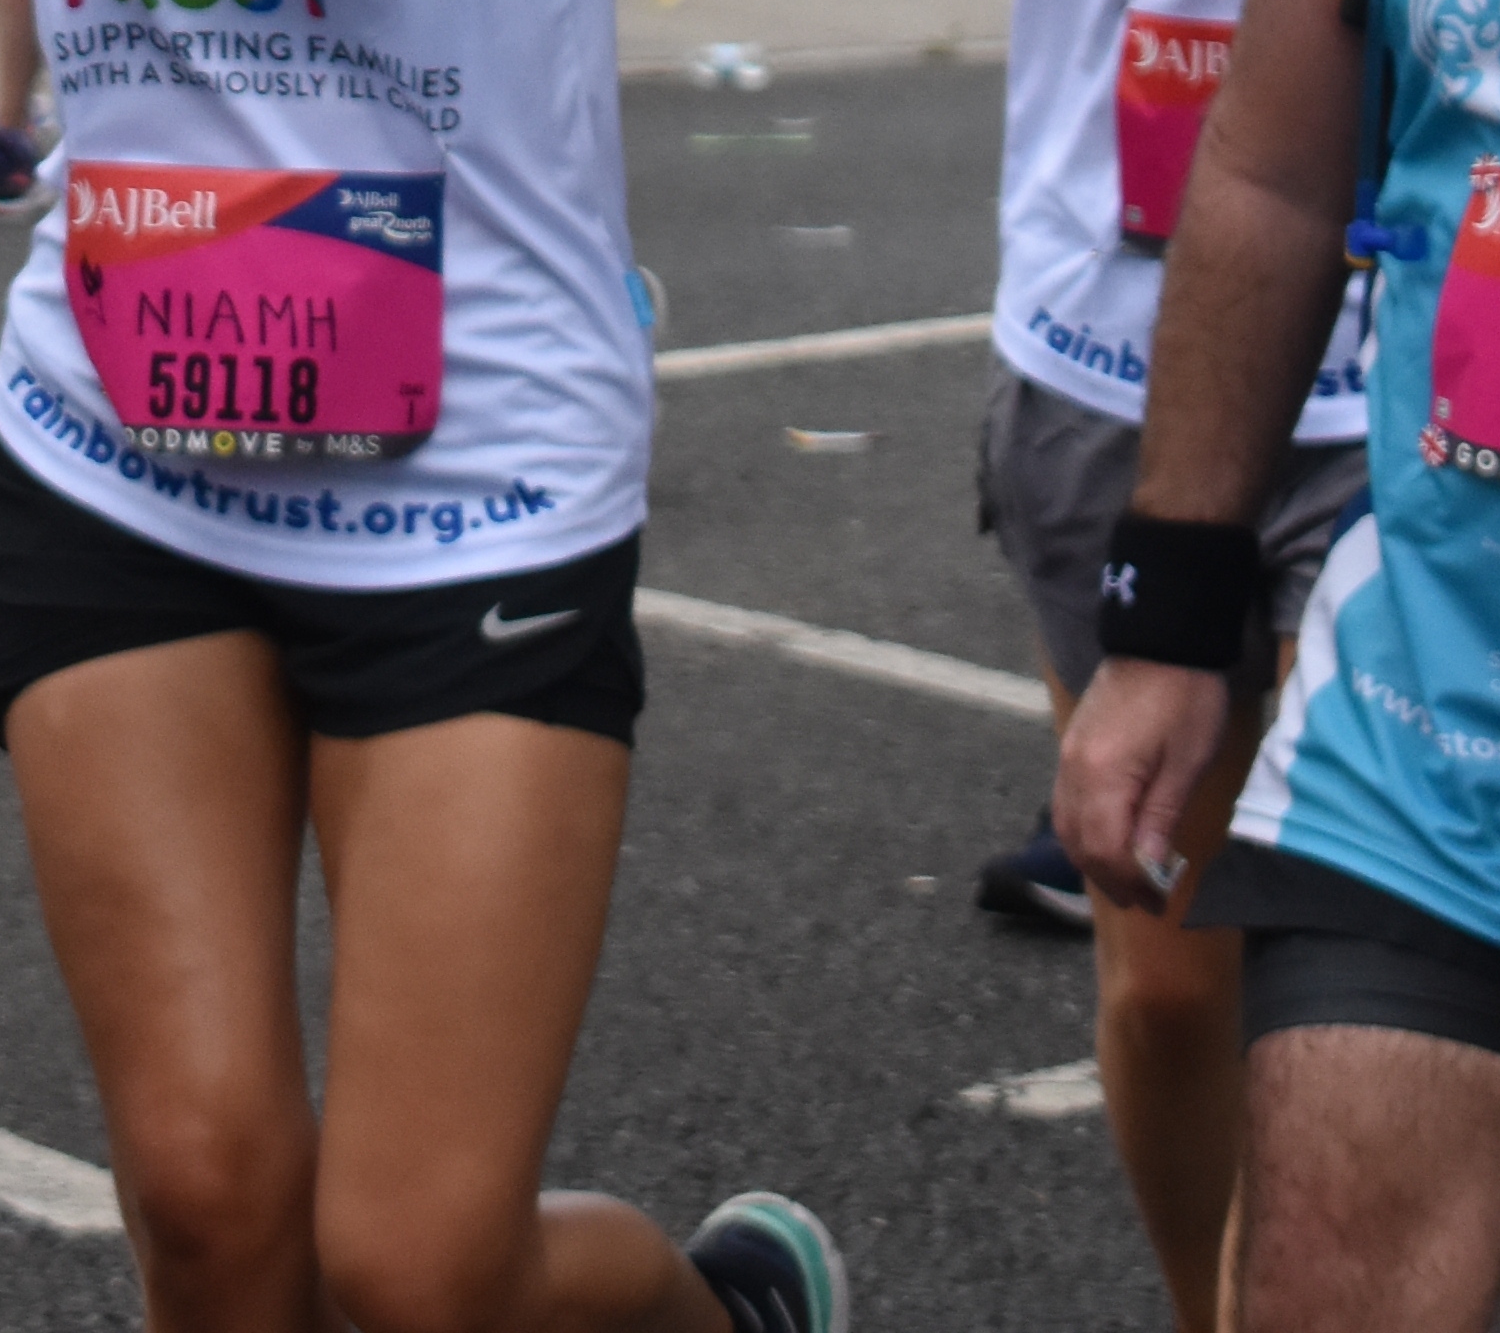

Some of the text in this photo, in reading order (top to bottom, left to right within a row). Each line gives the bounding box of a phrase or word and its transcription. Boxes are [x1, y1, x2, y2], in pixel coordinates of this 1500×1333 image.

[55, 22, 461, 97] SUPPORTING FAMILIES
[61, 61, 130, 94] WITH
[140, 61, 161, 84] A
[338, 74, 379, 99] ILL
[1159, 37, 1232, 81] AJB
[99, 186, 219, 234] AJBell
[136, 288, 338, 352] NIAMH
[148, 353, 318, 424] 59118
[7, 365, 555, 545] rainbowtrust.org.uk
[123, 426, 283, 456] ODMOVE
[326, 434, 381, 456] M&S
